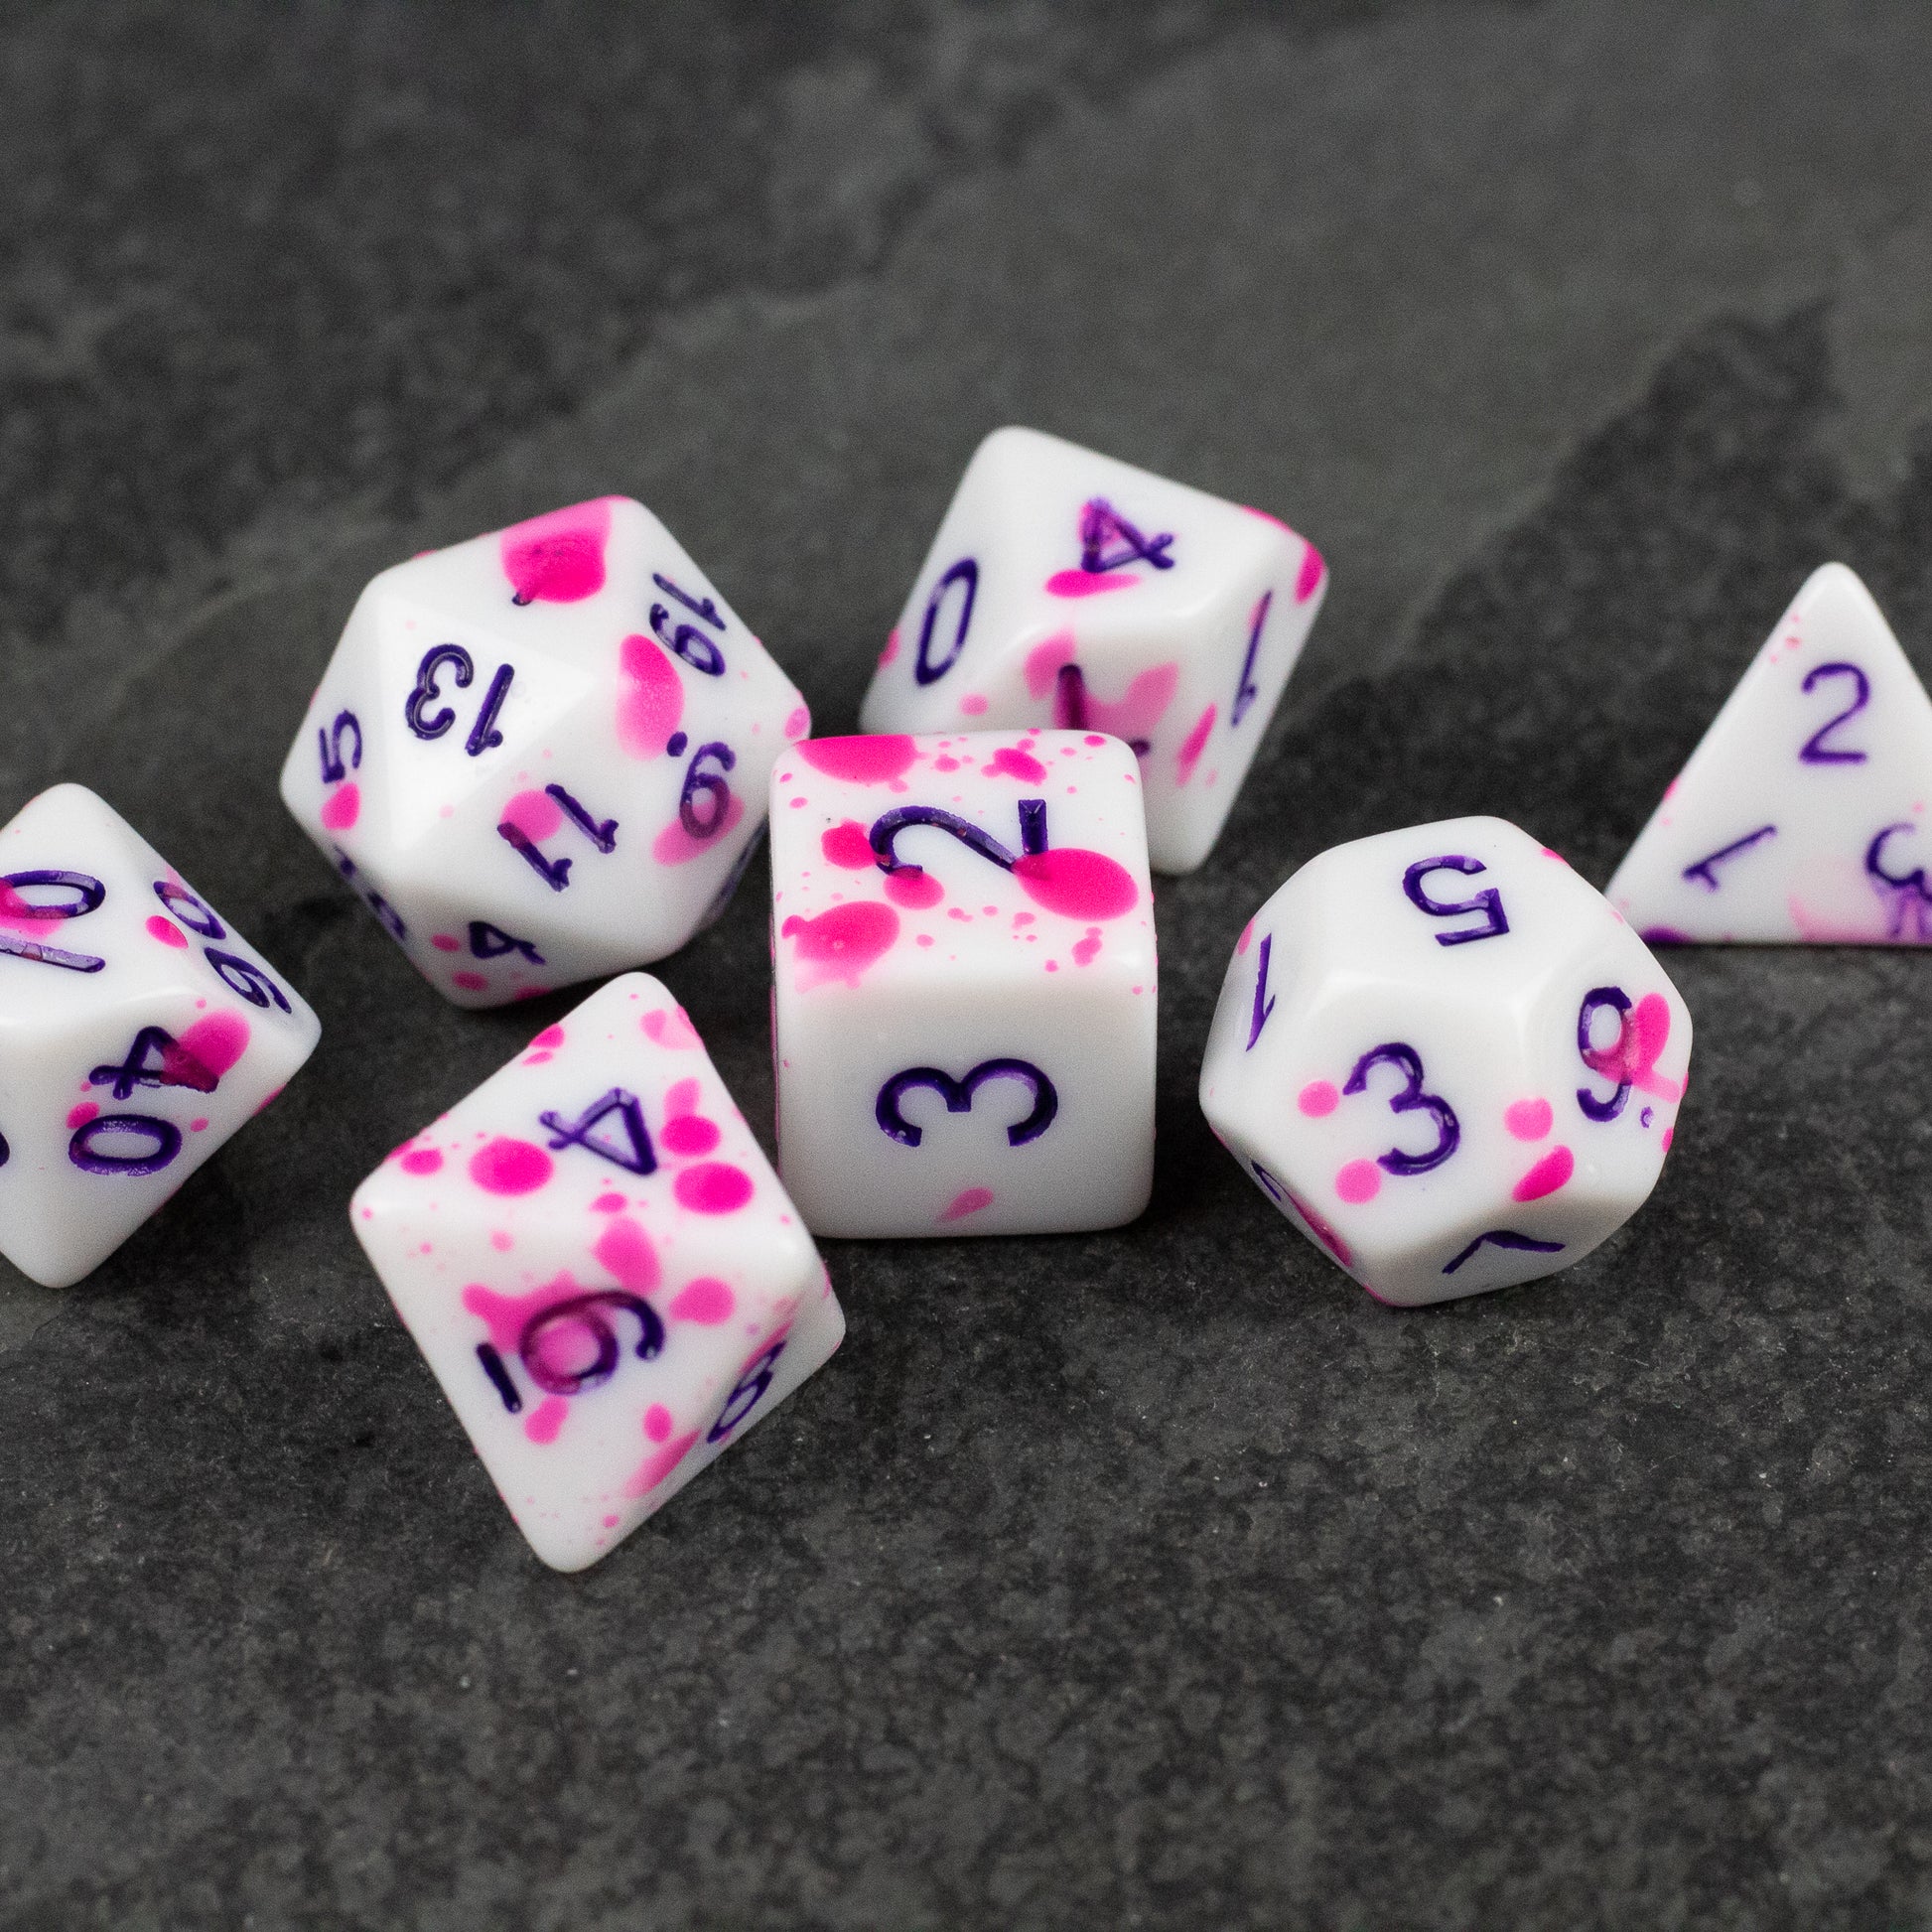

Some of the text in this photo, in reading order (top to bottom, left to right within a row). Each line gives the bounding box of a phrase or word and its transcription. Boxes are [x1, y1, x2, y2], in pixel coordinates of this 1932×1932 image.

[1081, 497, 1174, 572] 4
[647, 573, 727, 677] 19
[914, 557, 978, 687] 0
[319, 710, 362, 784] 5
[406, 643, 515, 758] 13
[1799, 660, 1870, 764] 2
[497, 783, 620, 893] 11
[870, 799, 1048, 879] 2
[1681, 824, 1777, 893] 1
[1402, 854, 1509, 947] 5
[69, 1026, 219, 1177] 40
[538, 1086, 658, 1175] 4
[875, 1058, 1058, 1148] 3
[1342, 1041, 1460, 1176] 3
